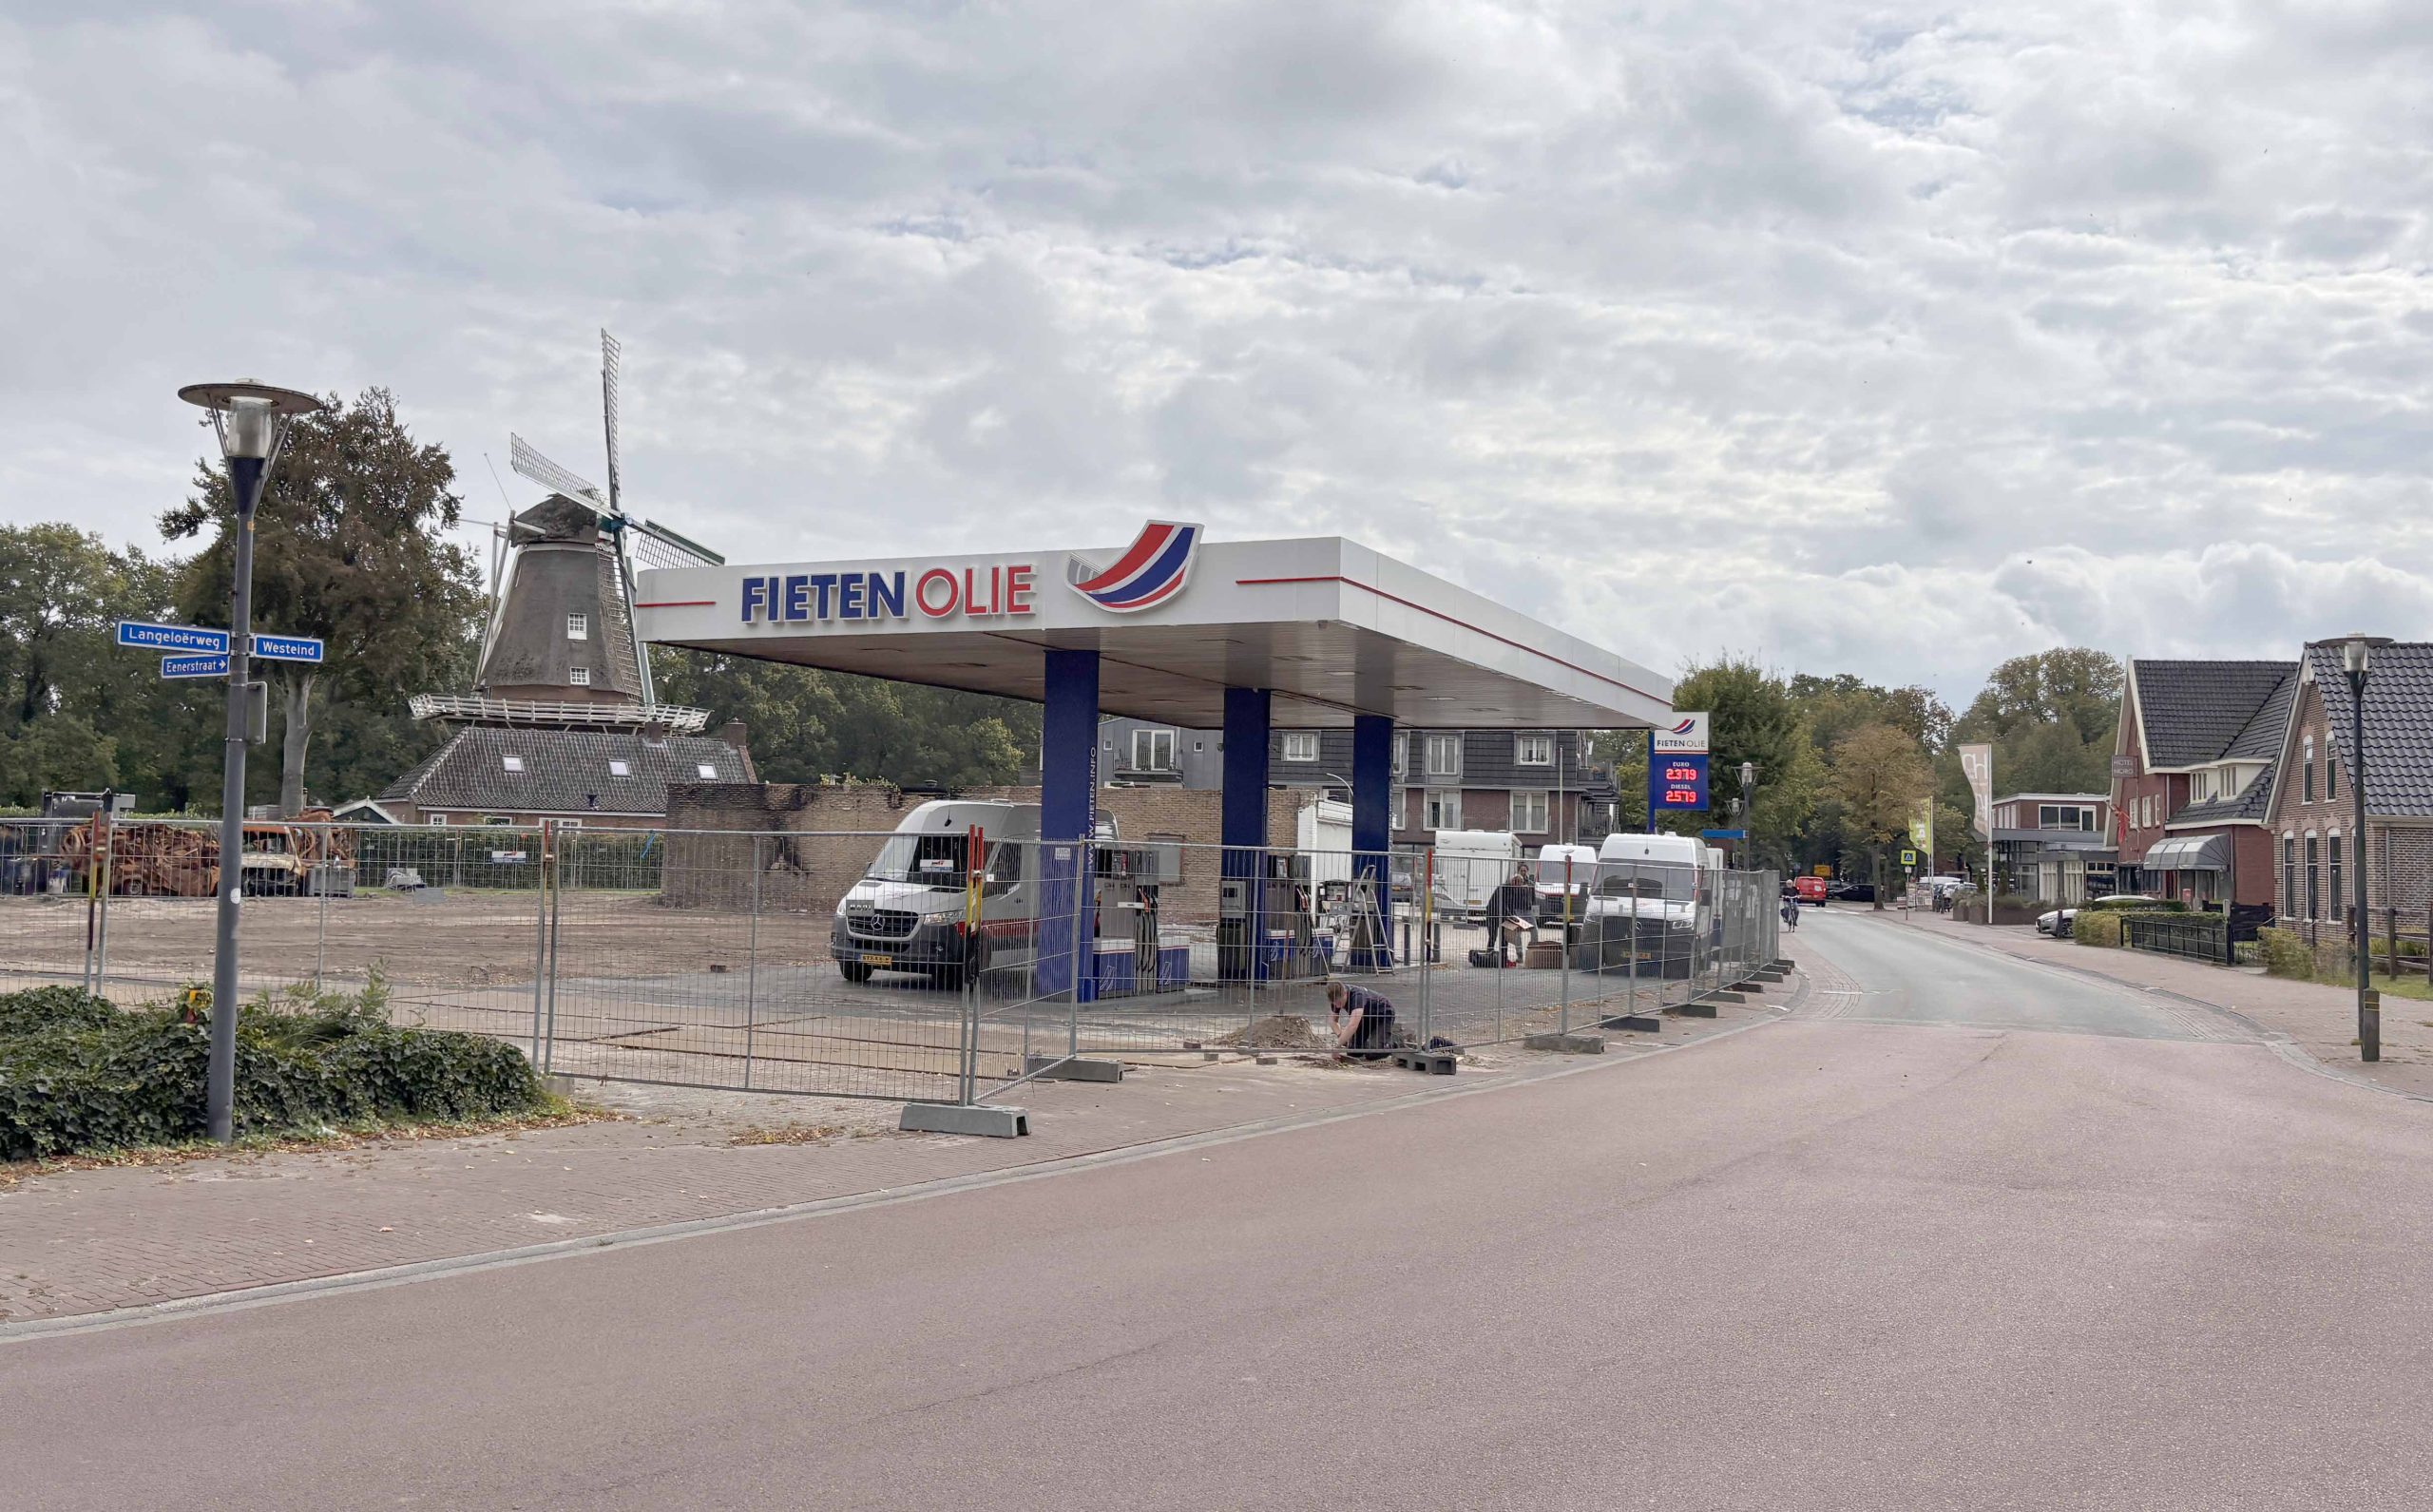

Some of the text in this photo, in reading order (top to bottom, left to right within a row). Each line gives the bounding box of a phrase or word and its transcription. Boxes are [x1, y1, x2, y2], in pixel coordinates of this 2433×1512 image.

[740, 565, 1036, 624] FIETEN OLIE
[128, 626, 220, 650] Langeloërweg
[262, 641, 316, 656] Westeind
[165, 660, 217, 673] Eenerstraat
